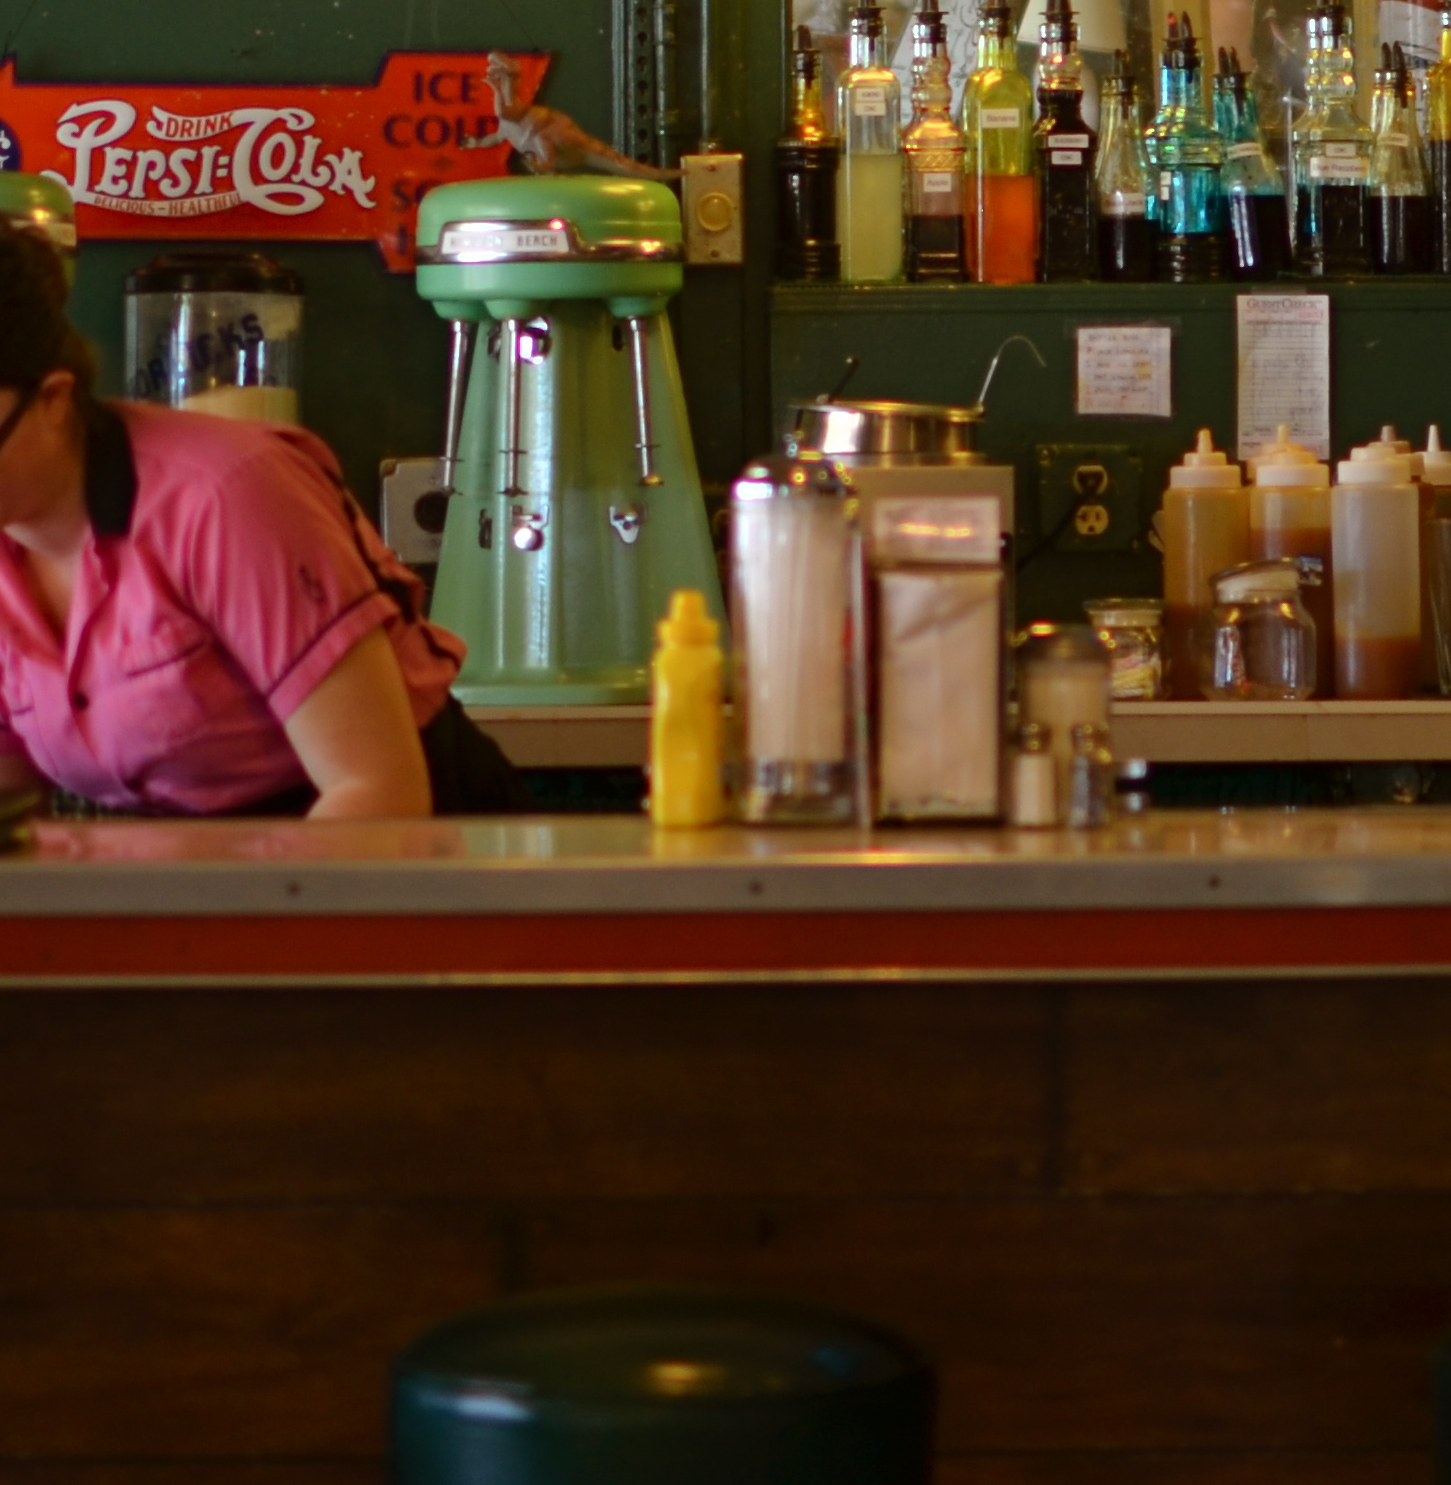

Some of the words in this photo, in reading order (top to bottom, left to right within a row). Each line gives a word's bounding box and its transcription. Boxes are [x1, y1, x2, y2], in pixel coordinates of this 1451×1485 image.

[414, 71, 479, 104] ICE
[164, 112, 234, 139] DRINK
[516, 234, 558, 247] BEACH
